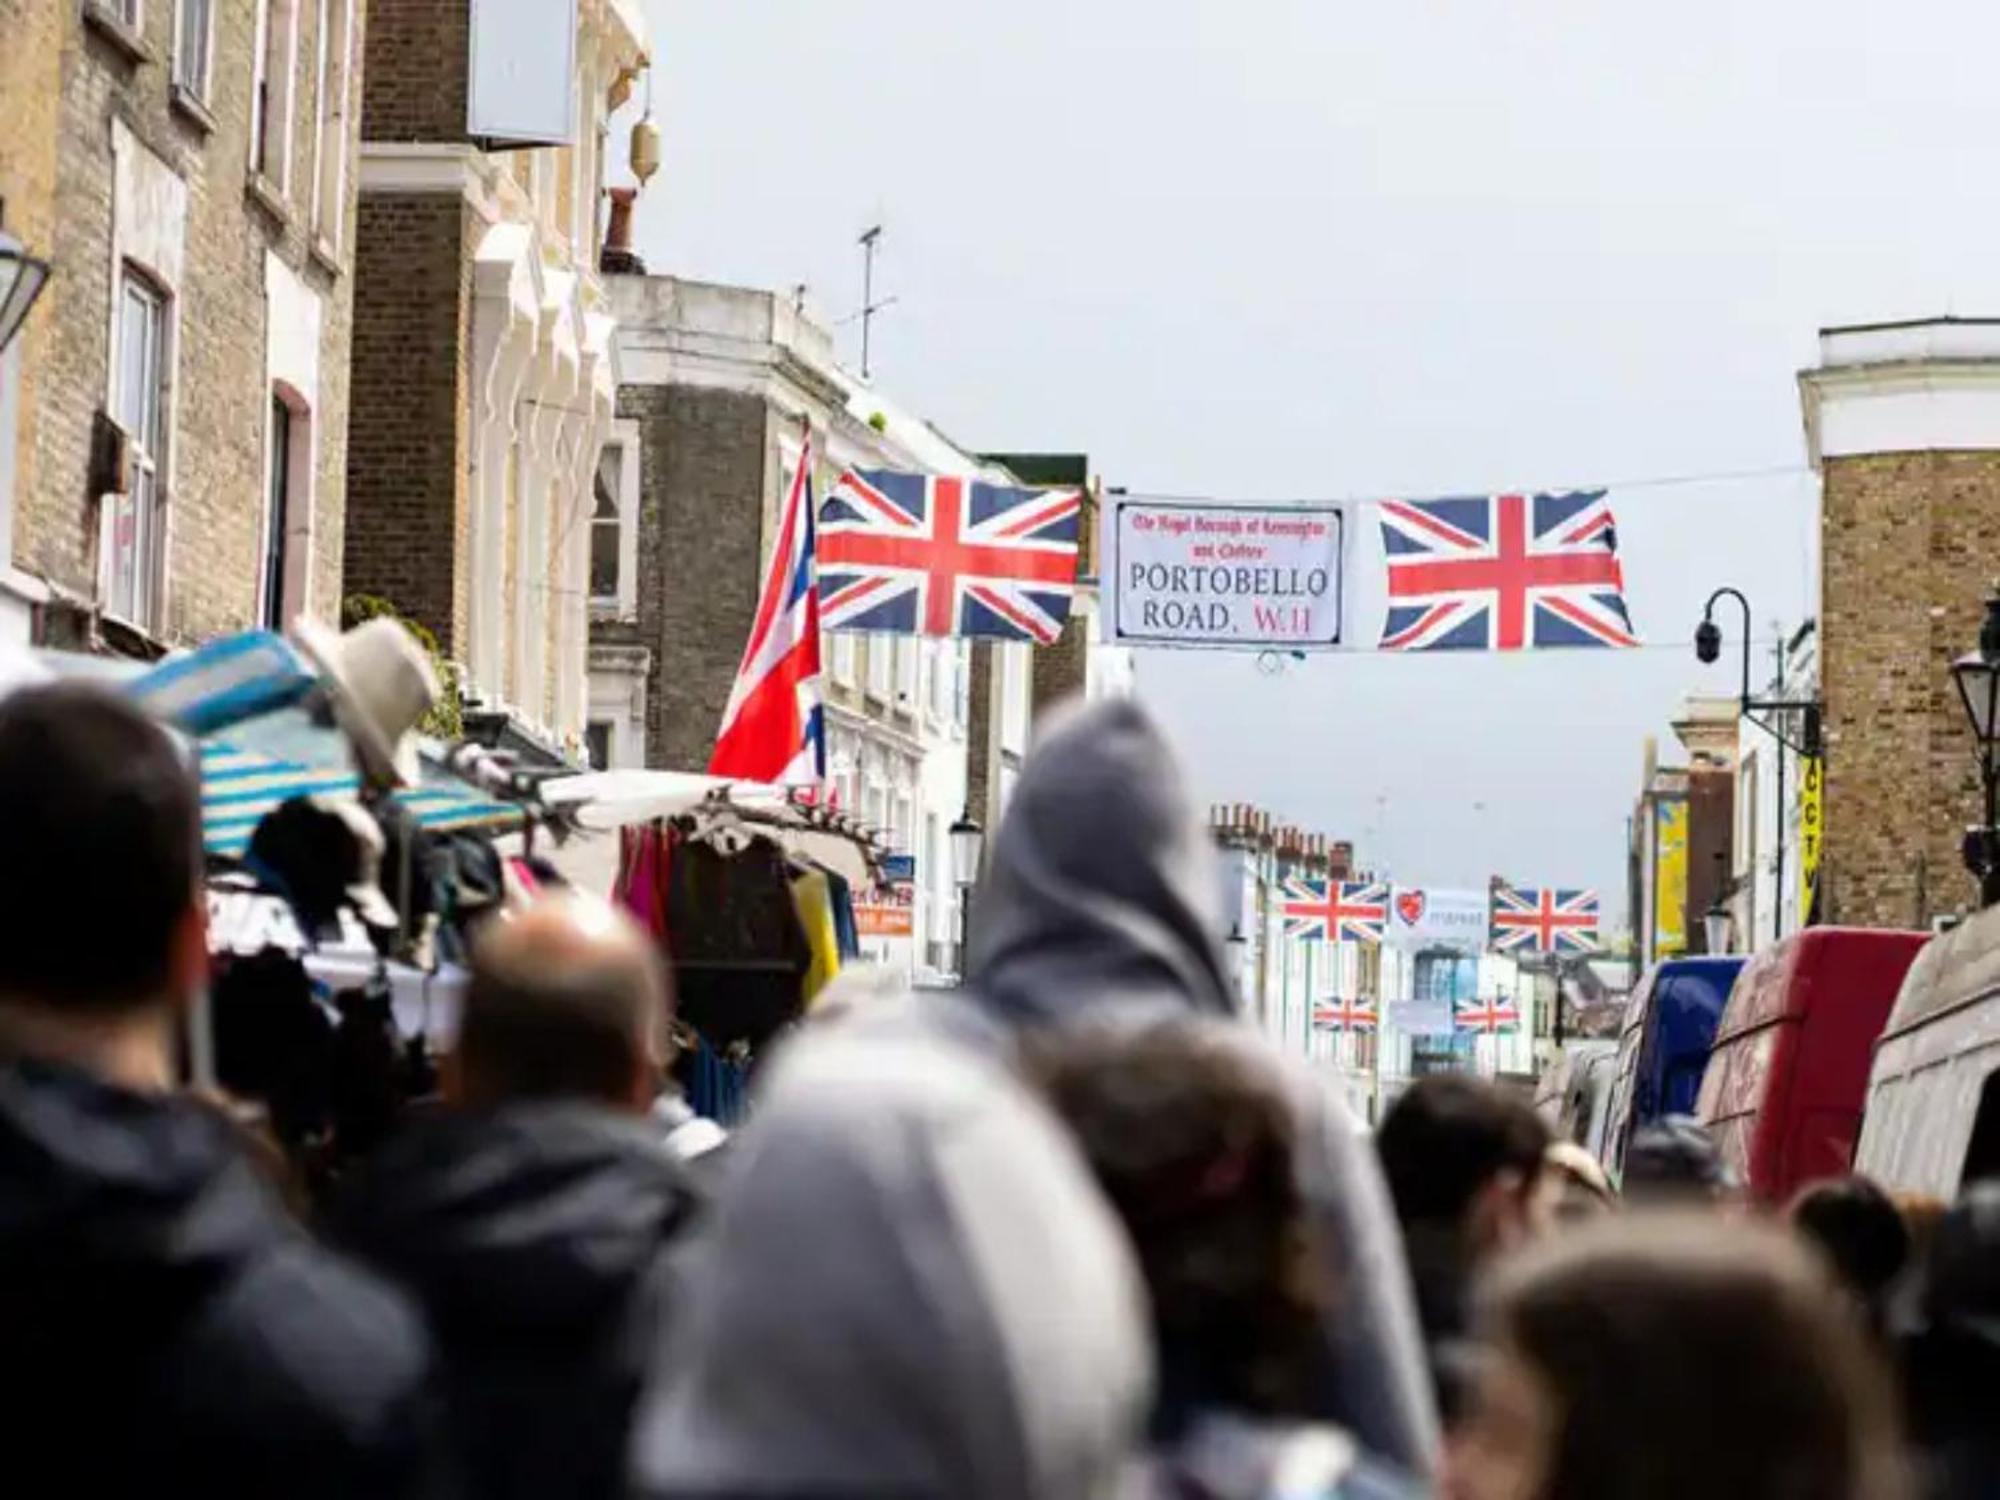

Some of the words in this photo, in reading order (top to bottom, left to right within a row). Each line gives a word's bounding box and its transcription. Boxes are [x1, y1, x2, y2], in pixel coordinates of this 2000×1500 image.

[1246, 519, 1260, 533] of
[1130, 562, 1328, 598] PORTOBELLO
[1804, 771, 1818, 888] CCTV
